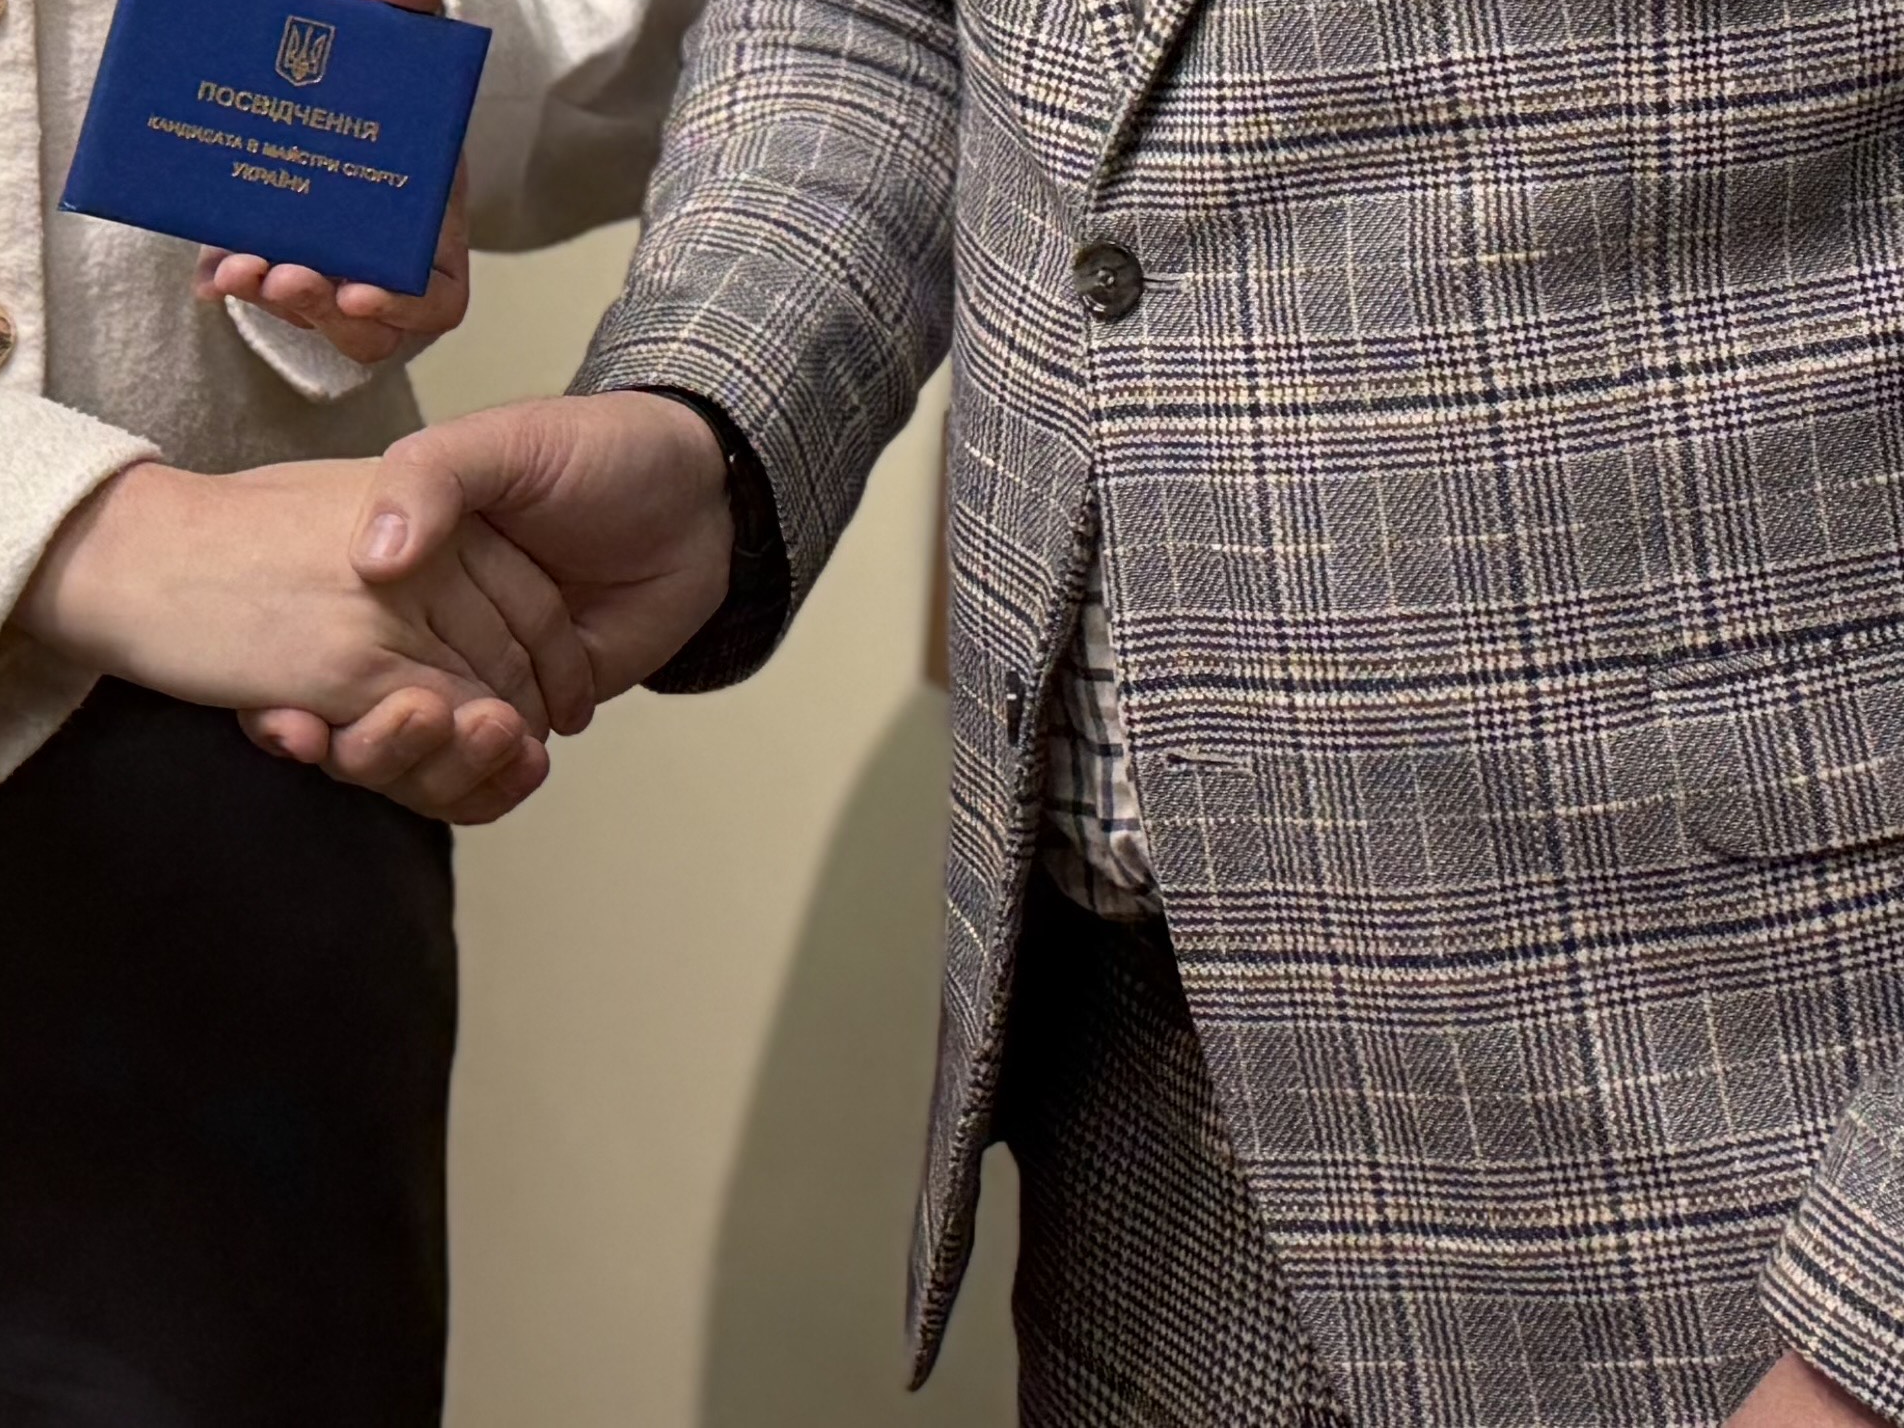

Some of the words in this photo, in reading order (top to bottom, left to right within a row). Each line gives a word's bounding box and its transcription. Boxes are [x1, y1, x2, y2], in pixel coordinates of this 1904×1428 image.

[196, 80, 381, 143] ПОСВІДЧЕННЯ
[146, 113, 244, 150] КАНДИДАТА
[245, 137, 259, 154] В
[261, 142, 342, 174] МАЙСТРИ
[341, 161, 410, 188] СПОРТУ
[231, 160, 312, 195] УКРАЇНИ
